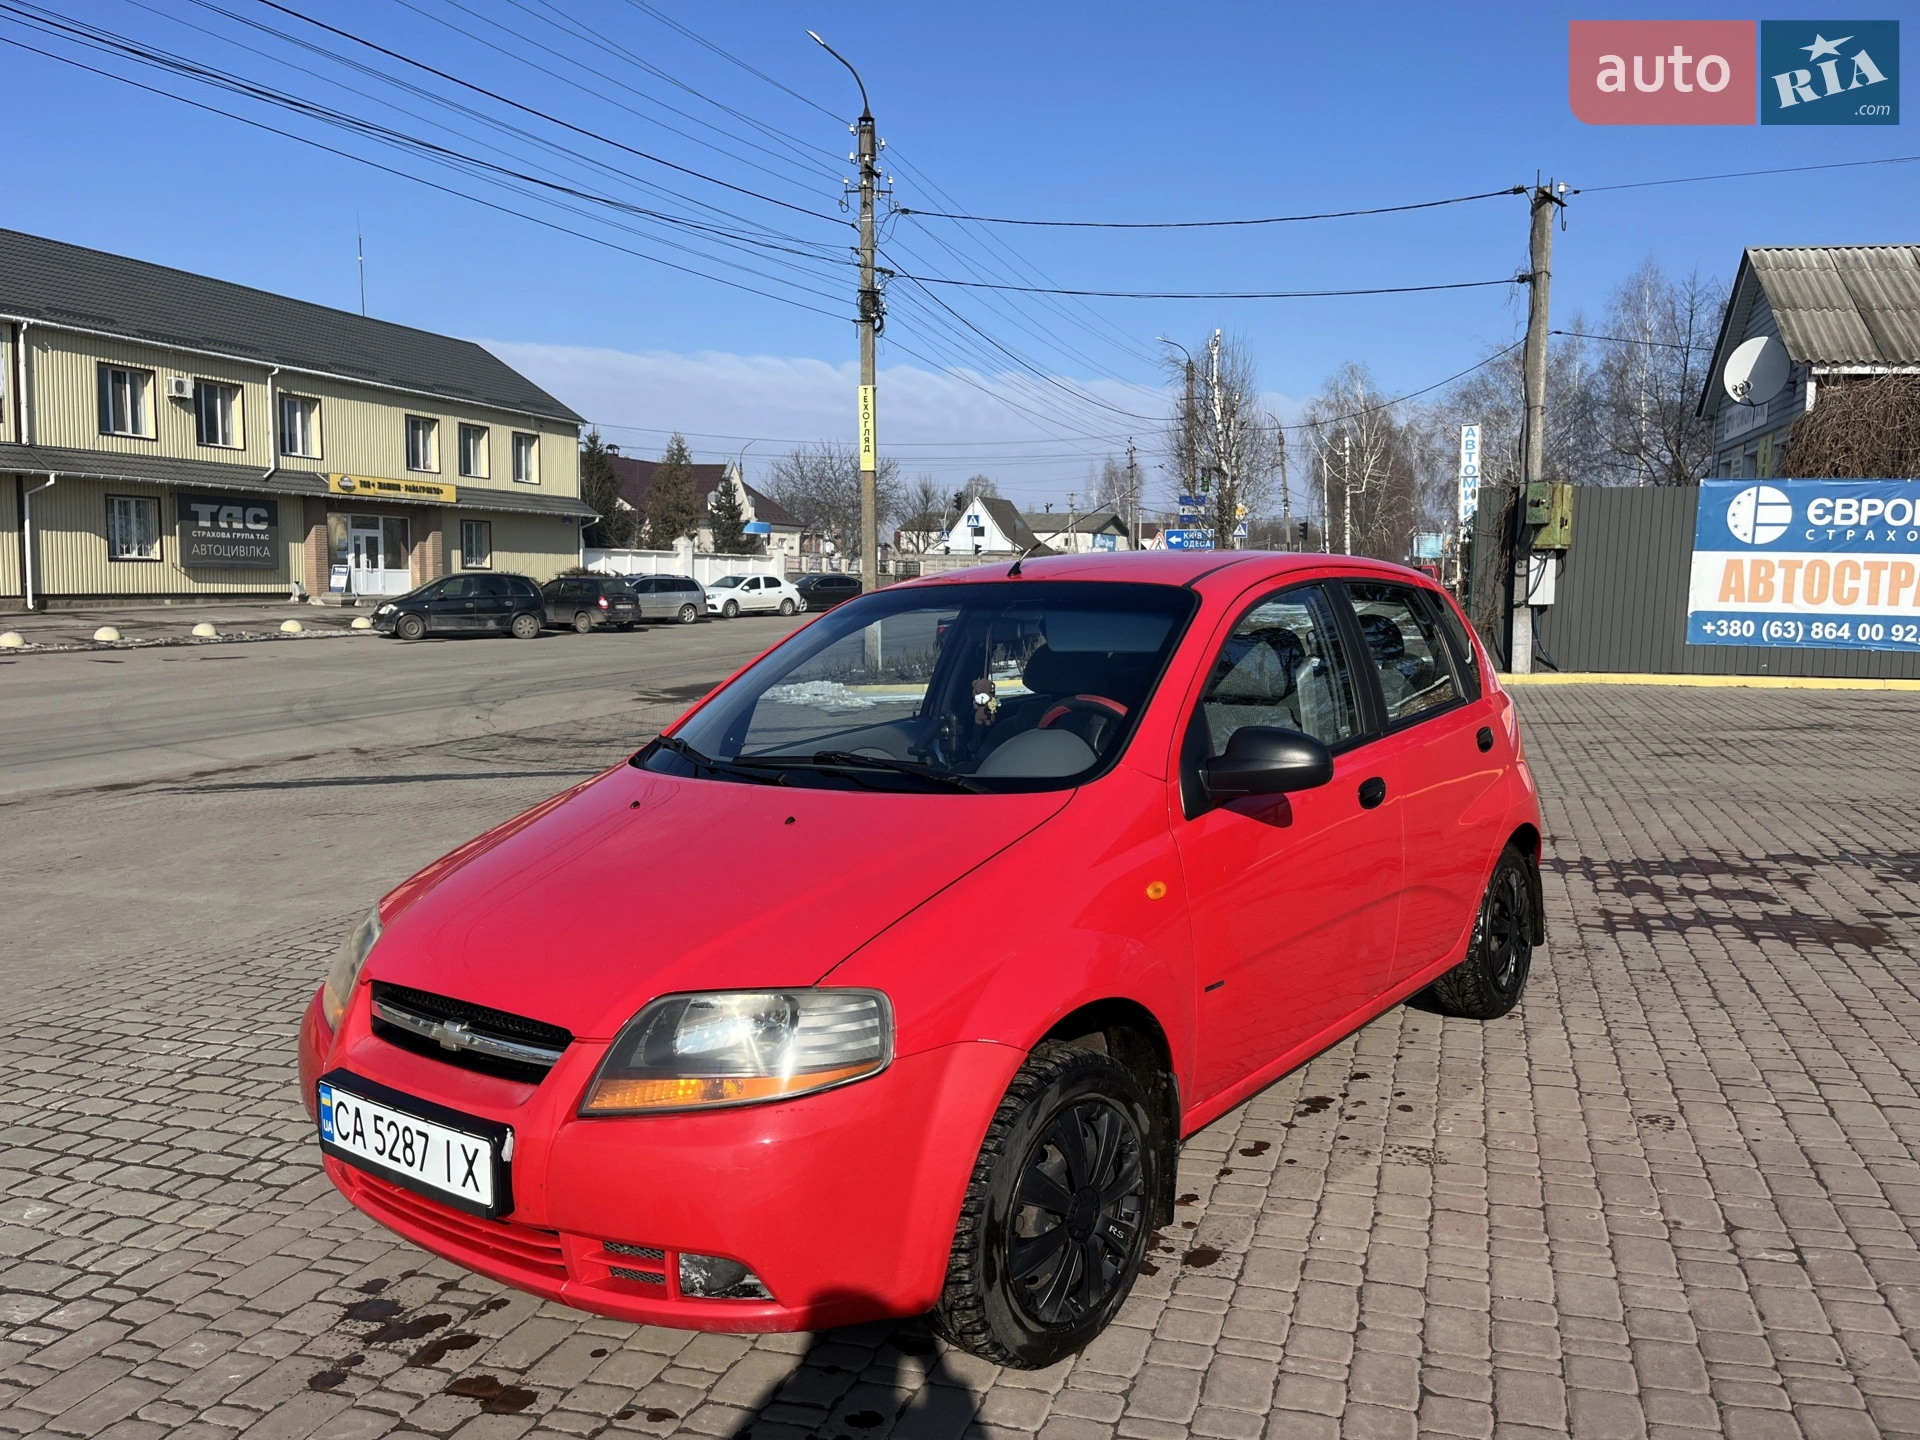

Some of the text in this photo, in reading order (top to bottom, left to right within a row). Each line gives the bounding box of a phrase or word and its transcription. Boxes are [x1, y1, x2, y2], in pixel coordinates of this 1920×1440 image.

[862, 387, 870, 453] ТЕХОГЛЯД
[190, 503, 269, 531] ТАС
[191, 530, 270, 541] СТРАХОВА ГРУПА ТАС
[1183, 531, 1202, 540] КИЇВ
[1806, 529, 1919, 542] СТРАХО
[191, 544, 271, 558] АВТОЦИВІЛКА
[1183, 540, 1211, 548] ОДЕСА
[1702, 619, 1755, 637] +380
[1762, 620, 1804, 642] (63)
[1810, 622, 1850, 640] 864
[1857, 623, 1883, 641] 00
[323, 1119, 333, 1133] UA
[335, 1101, 480, 1192] CA 5287 IX
